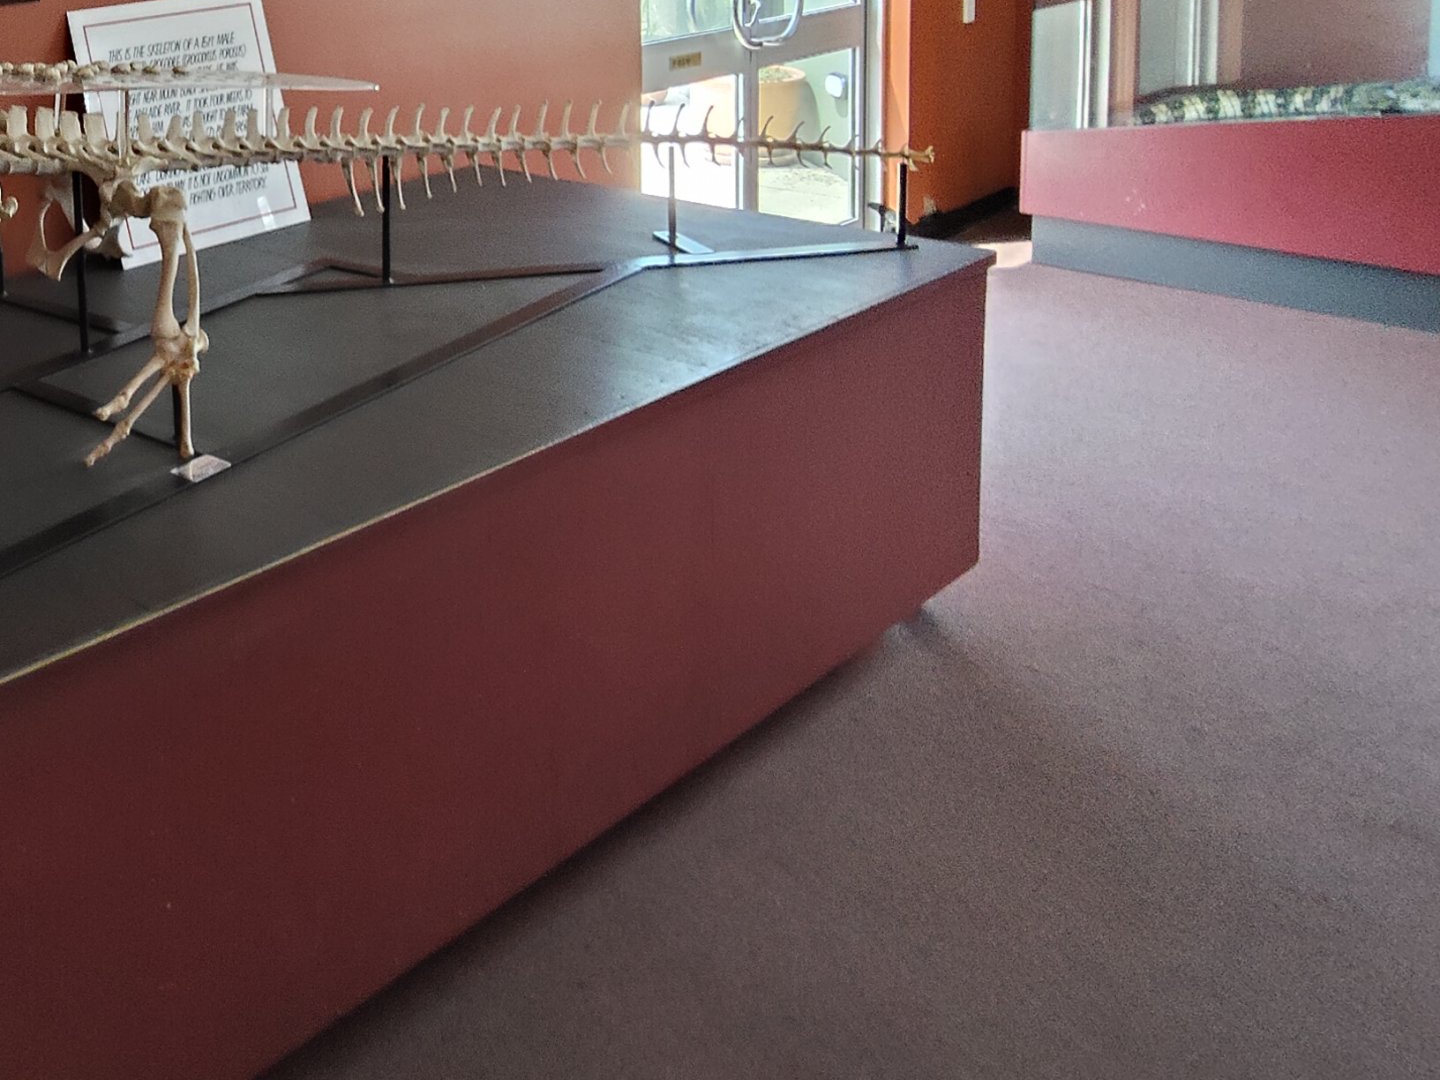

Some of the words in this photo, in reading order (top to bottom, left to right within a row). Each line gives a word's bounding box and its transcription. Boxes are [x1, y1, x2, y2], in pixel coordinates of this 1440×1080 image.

[109, 49, 122, 62] THIS
[124, 48, 131, 58] IS
[133, 45, 144, 59] THE
[147, 40, 181, 57] SKELETON
[183, 39, 192, 51] OF
[194, 37, 201, 48] A
[216, 31, 235, 44] MALE
